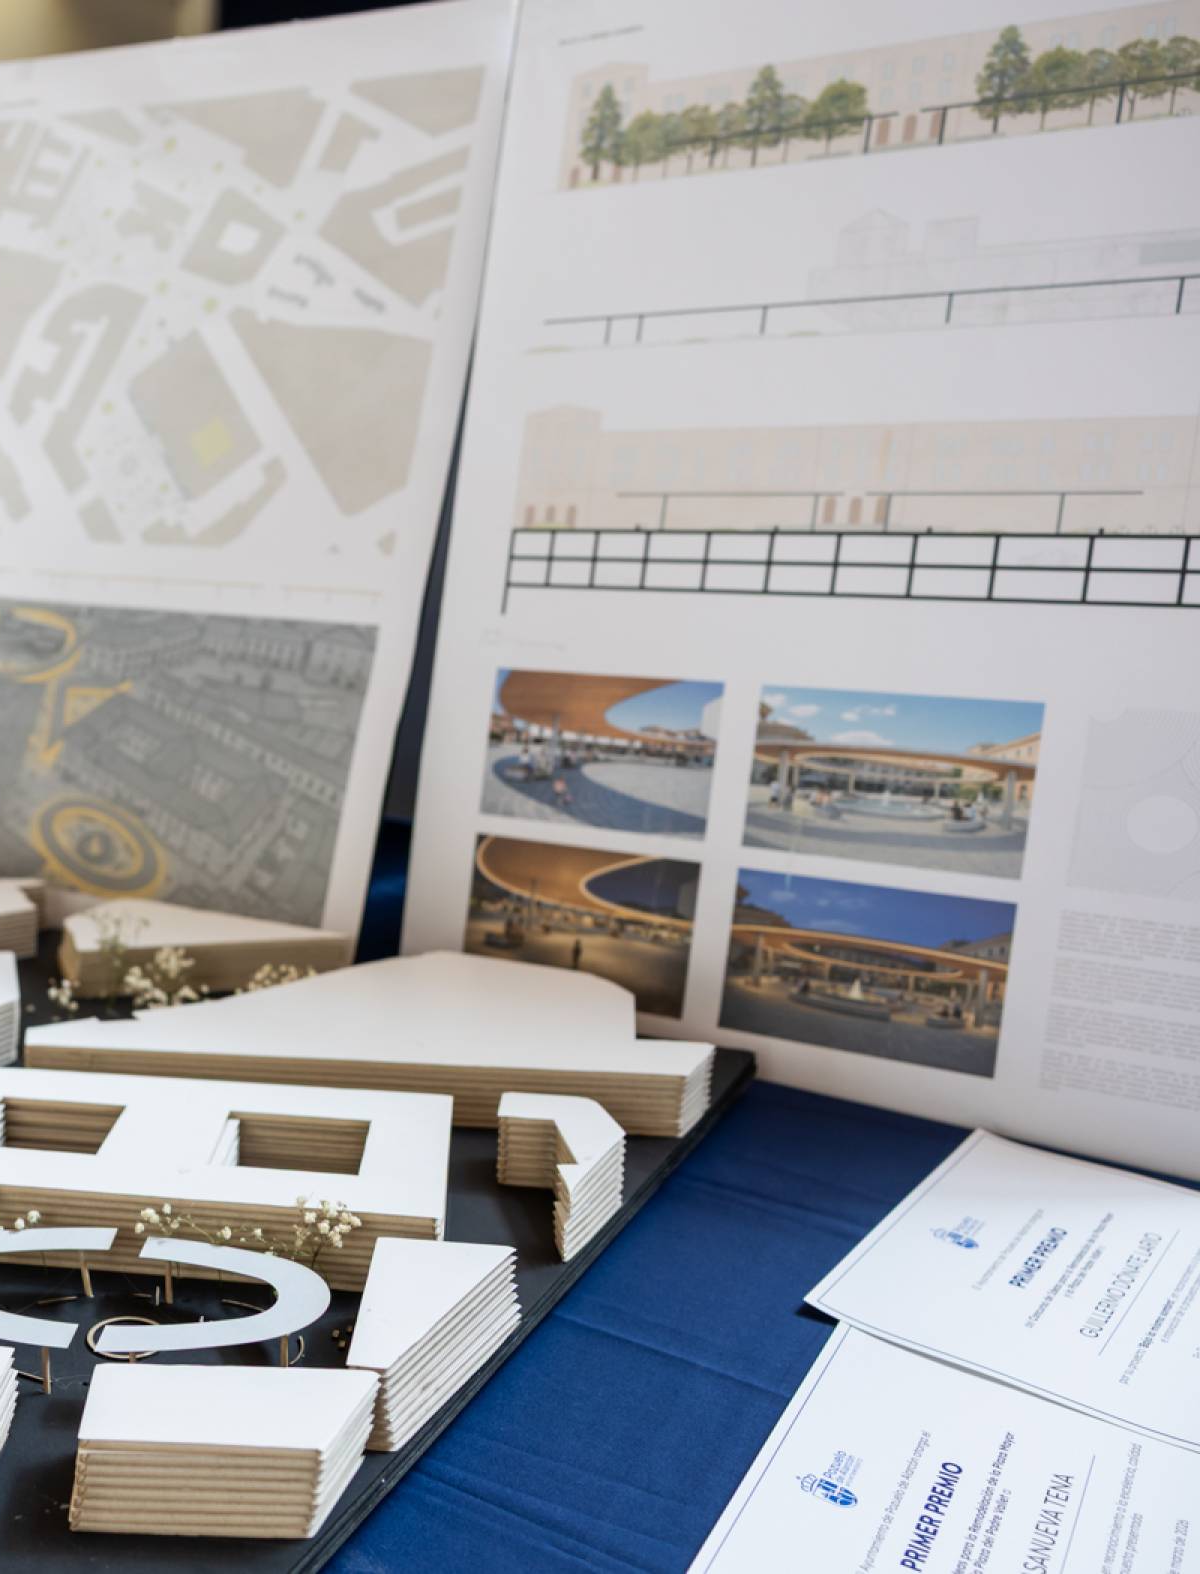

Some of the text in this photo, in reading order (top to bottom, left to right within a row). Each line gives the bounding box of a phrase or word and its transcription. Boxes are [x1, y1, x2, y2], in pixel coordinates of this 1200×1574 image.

[1009, 1228, 1067, 1288] PRIMER PREMIO
[900, 1463, 963, 1572] PRIMER PREMIO
[1023, 1474, 1074, 1574] SANUEVA TENA
